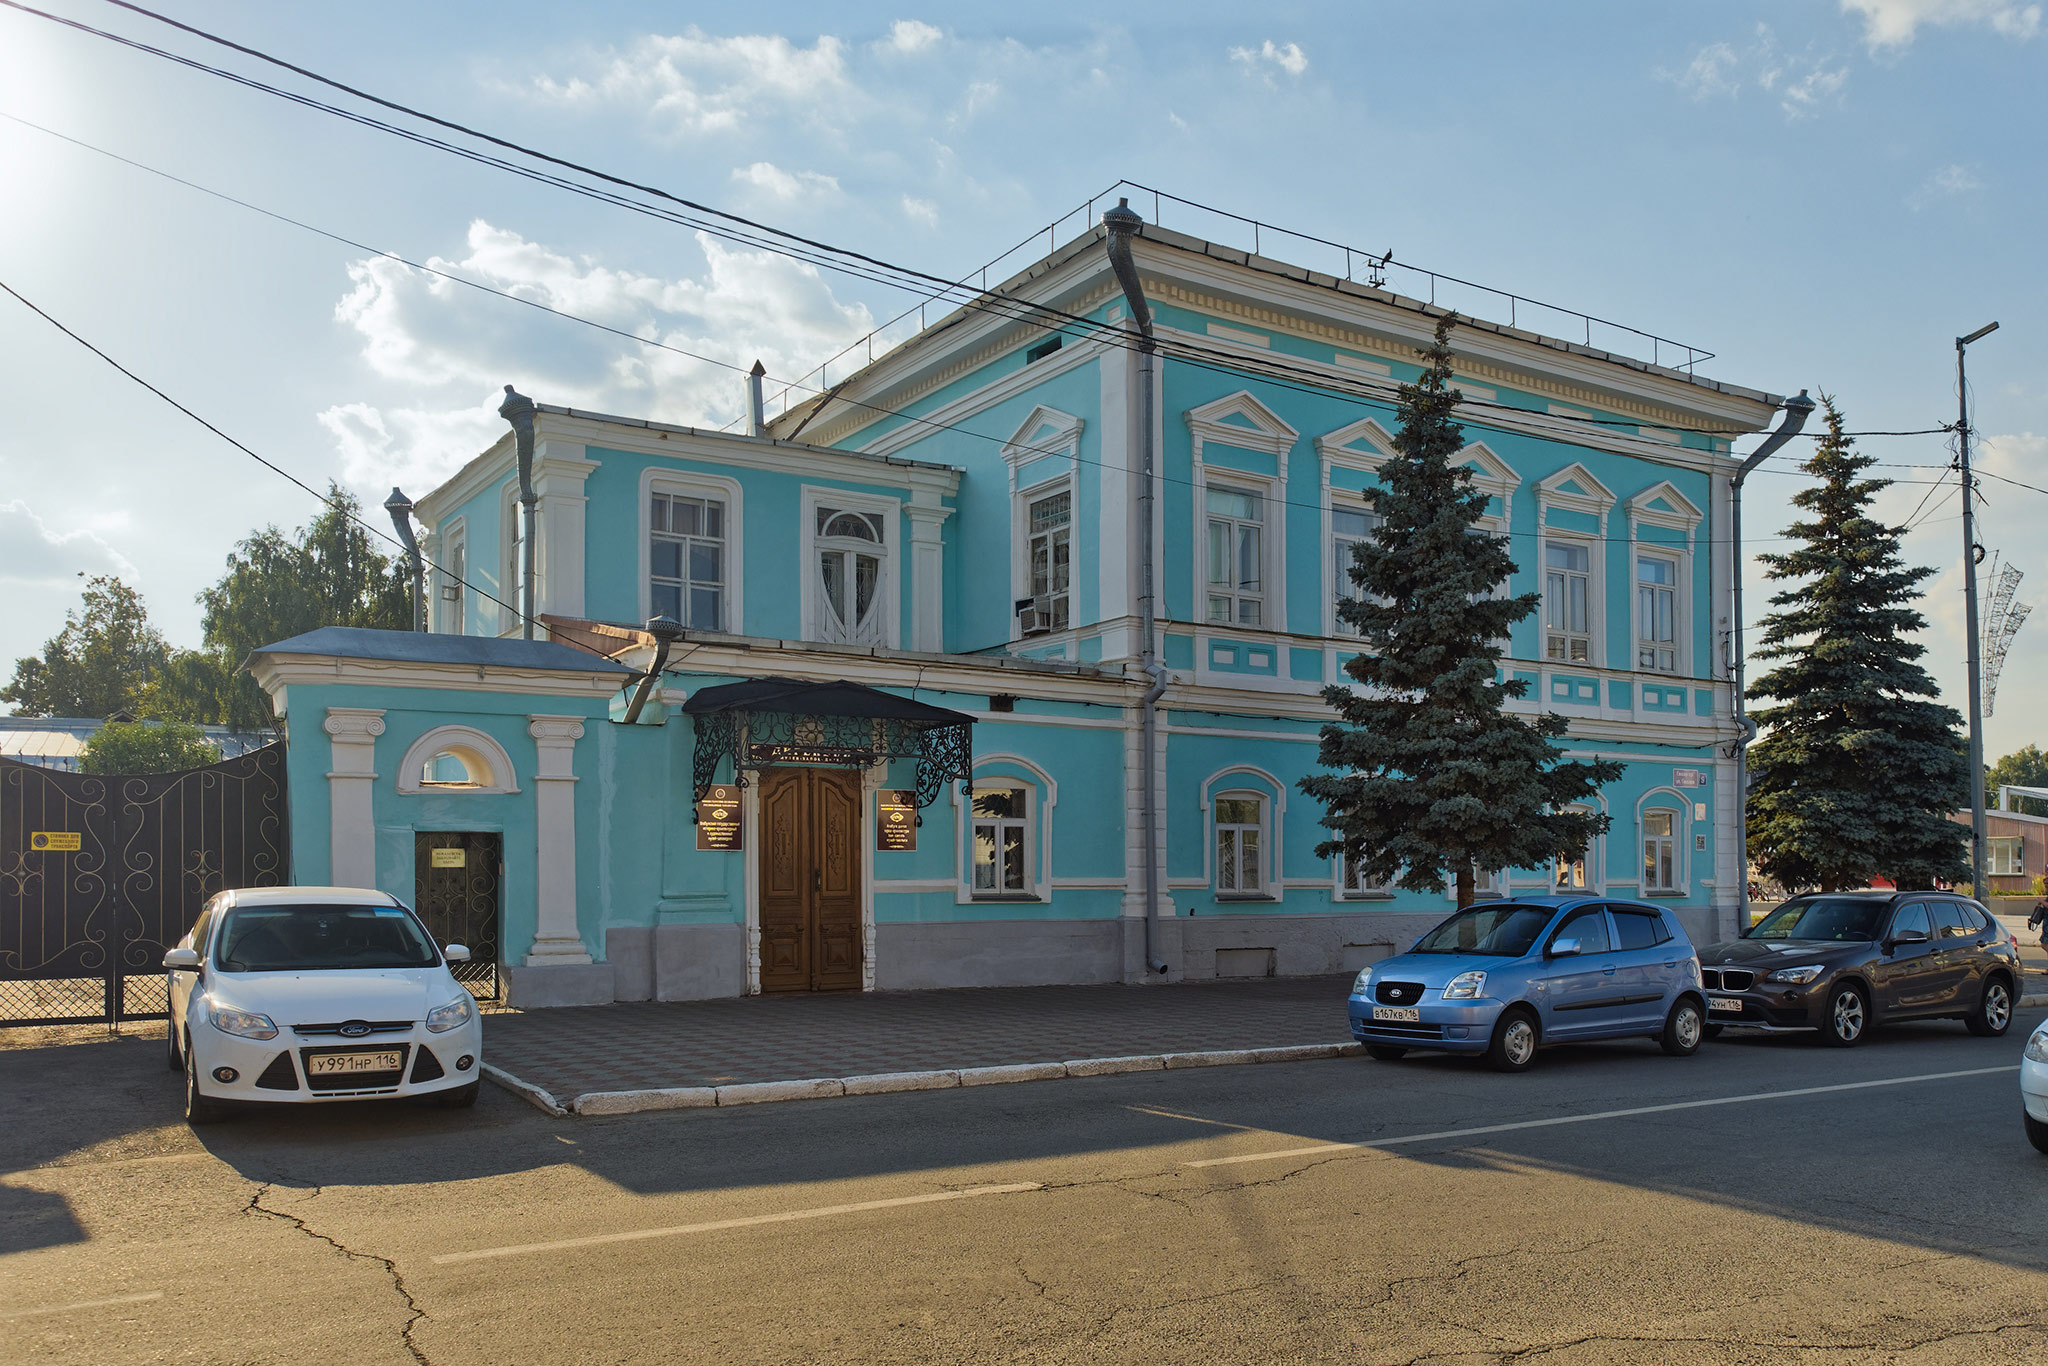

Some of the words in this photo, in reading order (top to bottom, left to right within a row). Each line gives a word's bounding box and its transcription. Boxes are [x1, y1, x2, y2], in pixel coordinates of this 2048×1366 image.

[1728, 1000, 1741, 1008] 116
[1375, 1009, 1403, 1019] В167КВ
[1403, 1009, 1418, 1018] 716
[346, 1026, 365, 1034] Ford
[317, 1057, 372, 1071] У991НР
[375, 1054, 396, 1065] 116
